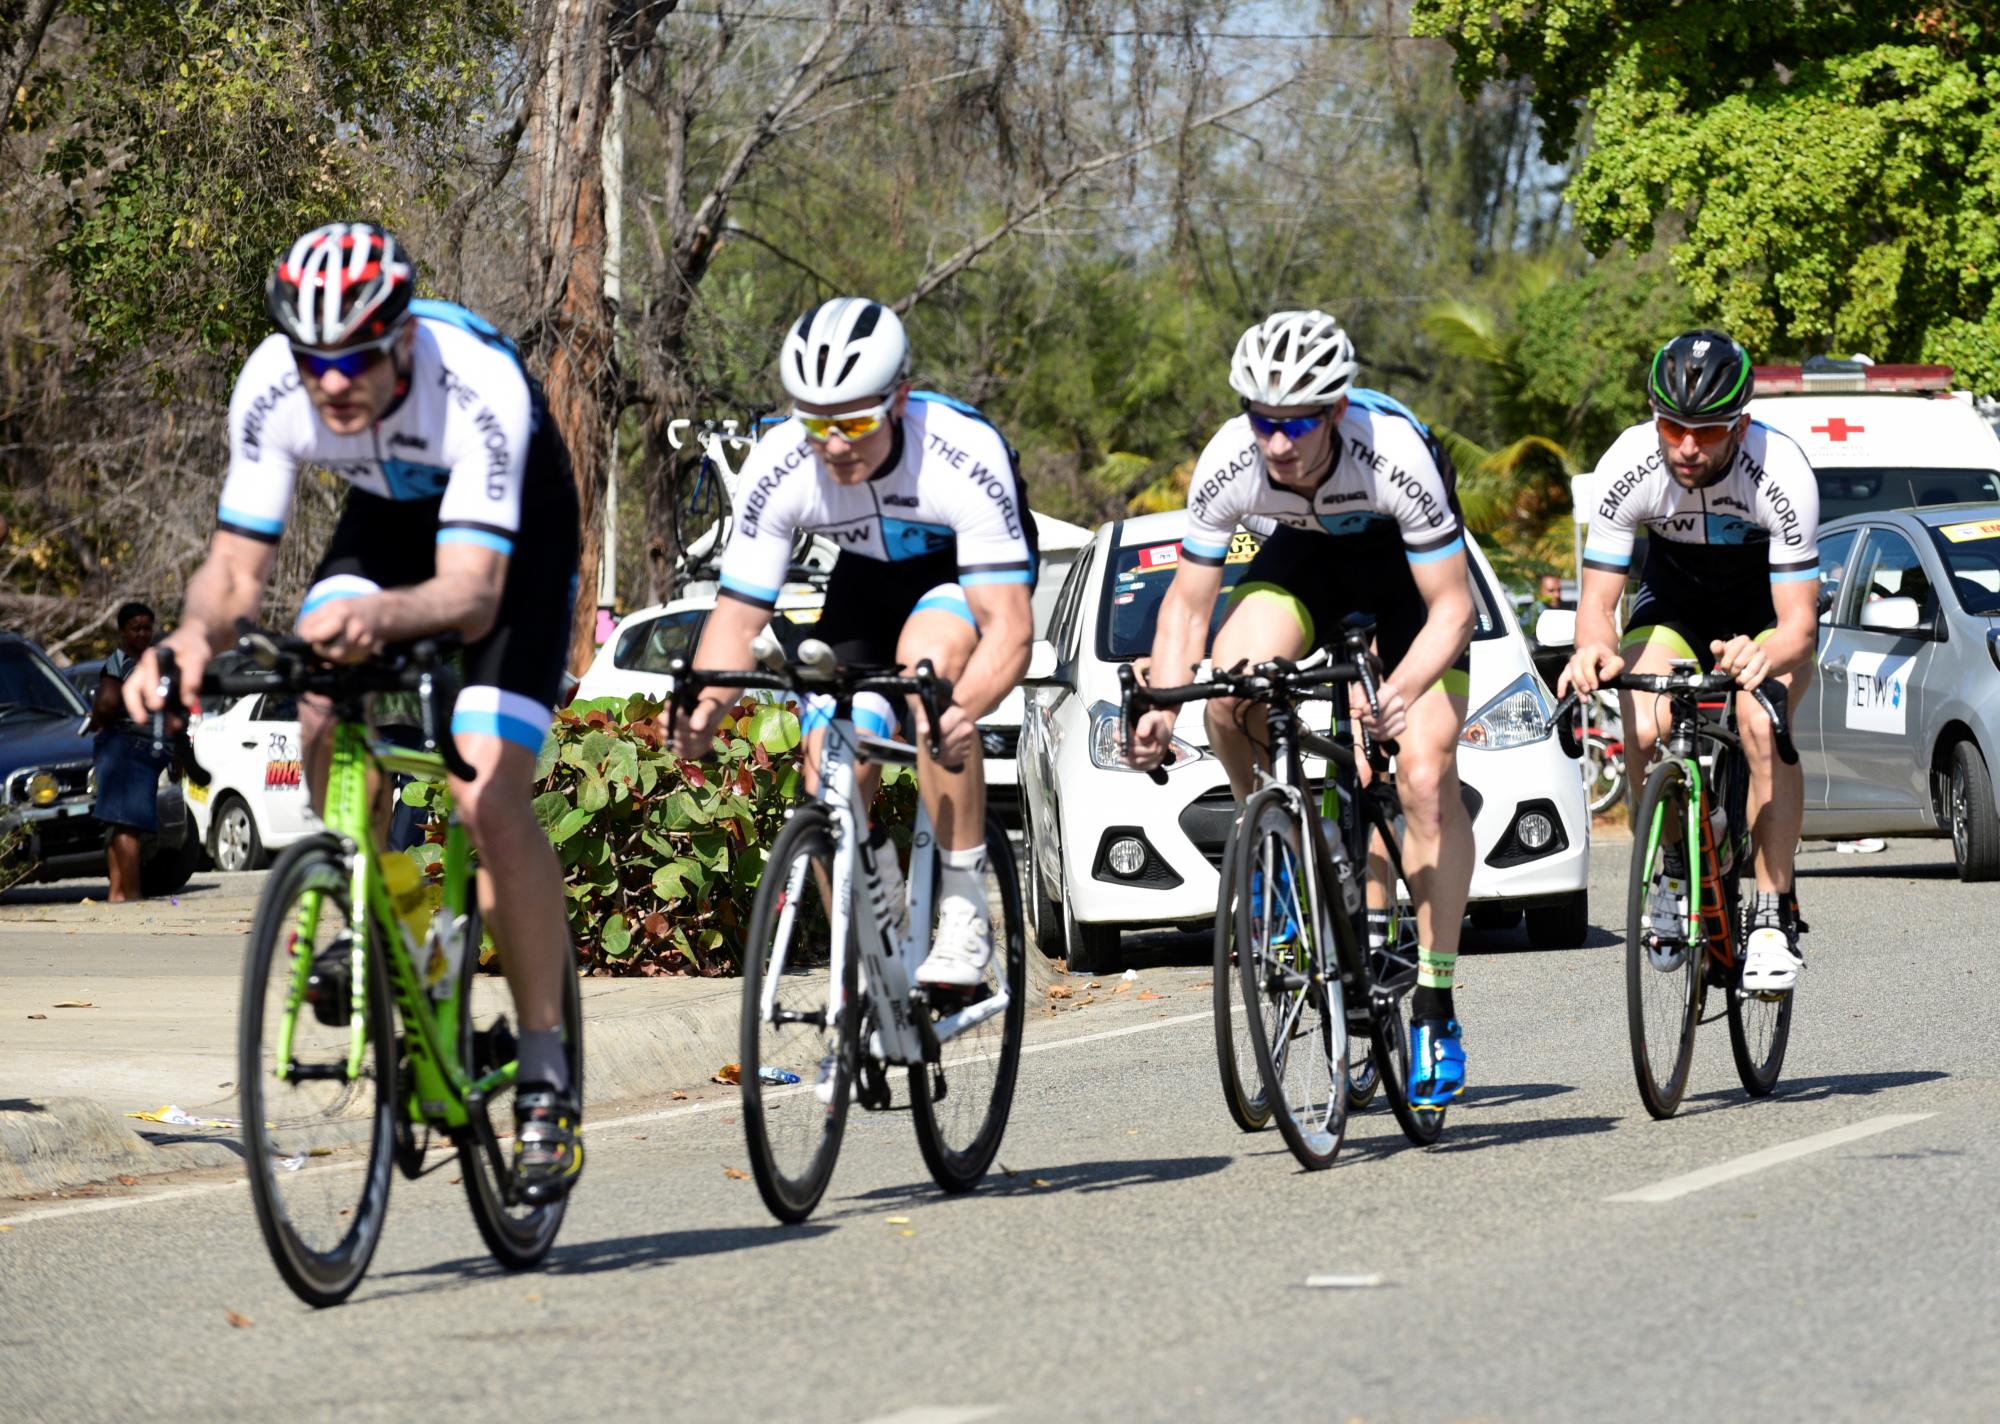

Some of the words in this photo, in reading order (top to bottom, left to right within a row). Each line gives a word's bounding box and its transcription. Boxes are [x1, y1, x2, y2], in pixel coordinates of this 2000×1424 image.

[241, 372, 301, 463] EMBRAC
[474, 406, 509, 501] WORLD
[740, 440, 814, 538] EMBRACE
[929, 433, 970, 470] THE
[969, 461, 1021, 540] WORLD
[1350, 438, 1389, 474] THE
[1389, 465, 1445, 528] WORLD
[1740, 450, 1768, 489] THE
[1764, 481, 1802, 546] WORLD
[1856, 673, 1888, 708] ETW
